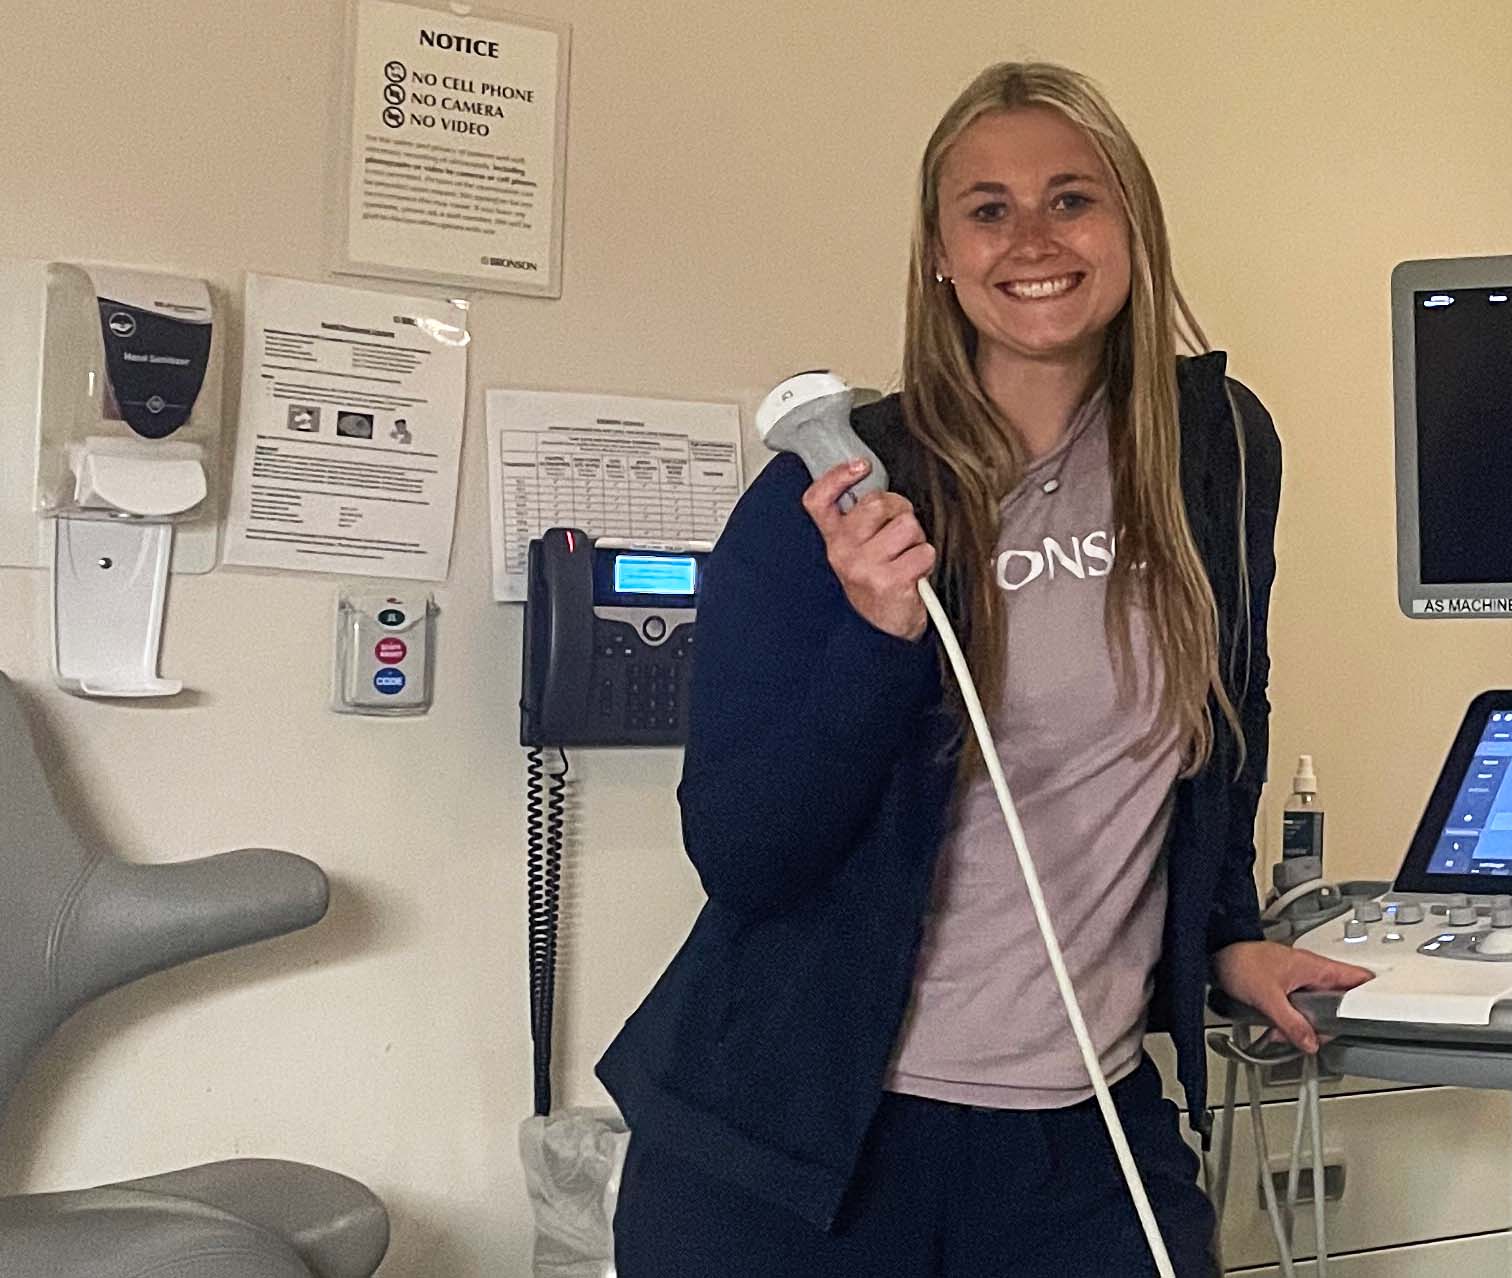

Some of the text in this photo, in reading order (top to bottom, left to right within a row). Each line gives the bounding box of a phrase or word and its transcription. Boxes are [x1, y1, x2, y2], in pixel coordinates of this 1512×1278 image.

[419, 29, 499, 59] NOTICE
[411, 71, 534, 103] NO CELL PHONE
[410, 92, 504, 119] NO CAMERA
[410, 113, 490, 137] NO VIDEO
[490, 257, 537, 271] BRONSON
[997, 530, 1117, 591] ONS
[1424, 599, 1444, 613] AS
